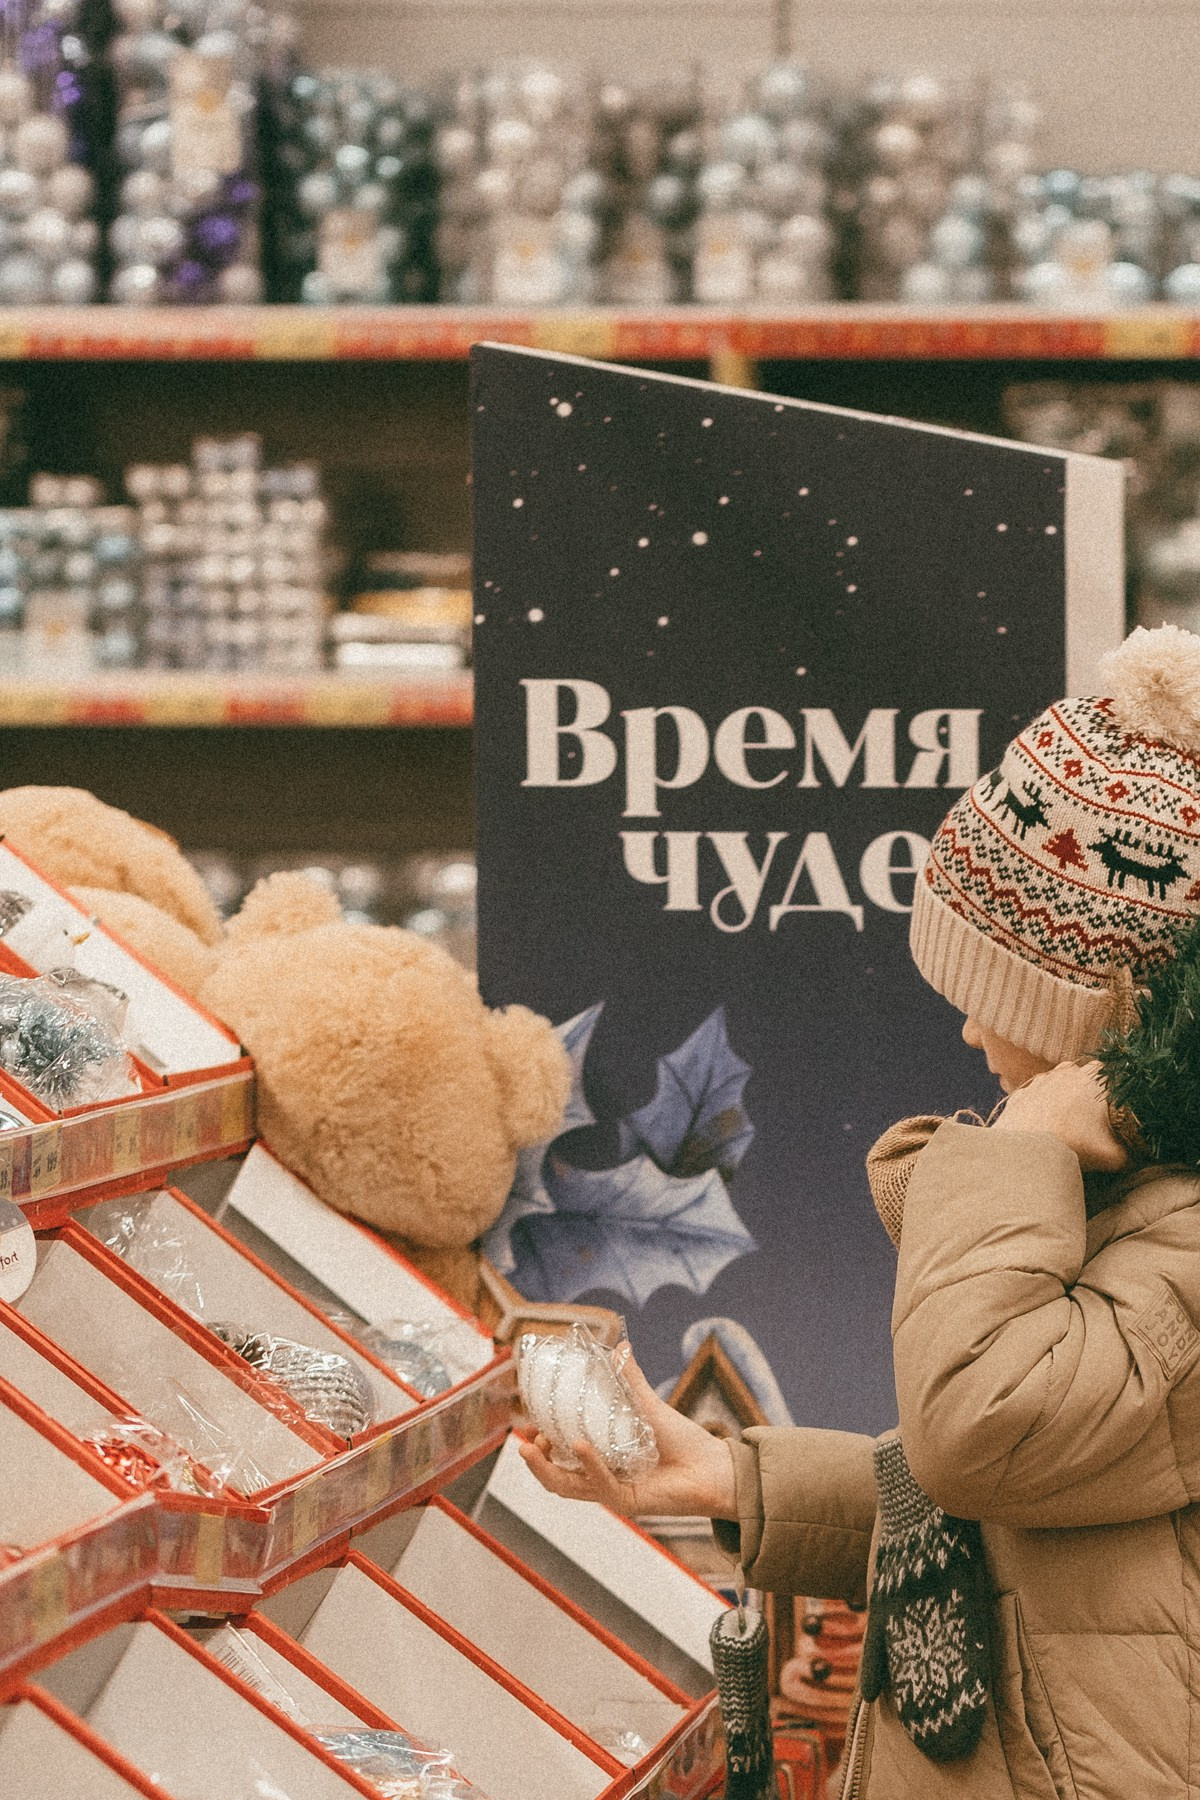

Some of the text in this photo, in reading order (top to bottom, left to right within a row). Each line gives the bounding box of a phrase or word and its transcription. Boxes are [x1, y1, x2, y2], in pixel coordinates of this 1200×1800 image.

[519, 678, 985, 817] Время
[618, 830, 932, 933] чуде
[1144, 1320, 1179, 1361] JOY
[1154, 1307, 1187, 1351] AND
[1164, 1295, 1196, 1343] FUN
